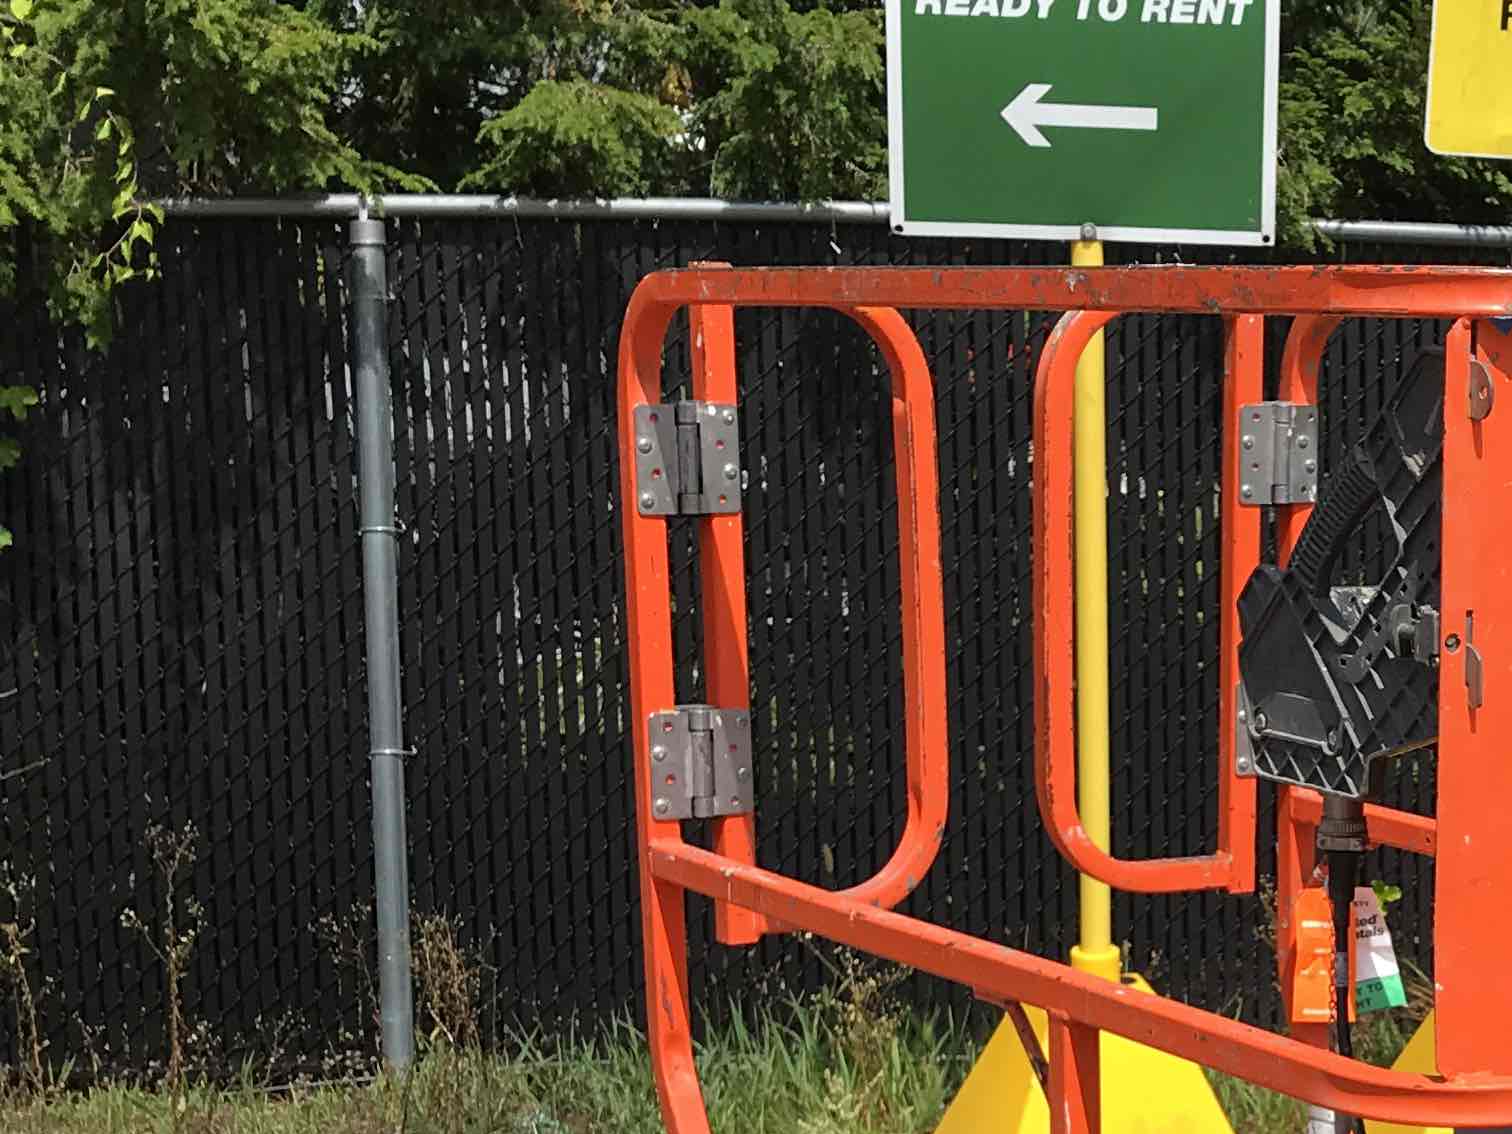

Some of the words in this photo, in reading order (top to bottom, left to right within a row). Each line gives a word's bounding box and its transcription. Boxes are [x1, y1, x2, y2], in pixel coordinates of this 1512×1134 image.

[914, 0, 1056, 20] READY
[1076, 0, 1128, 22] TO
[1141, 0, 1254, 25] RENT
